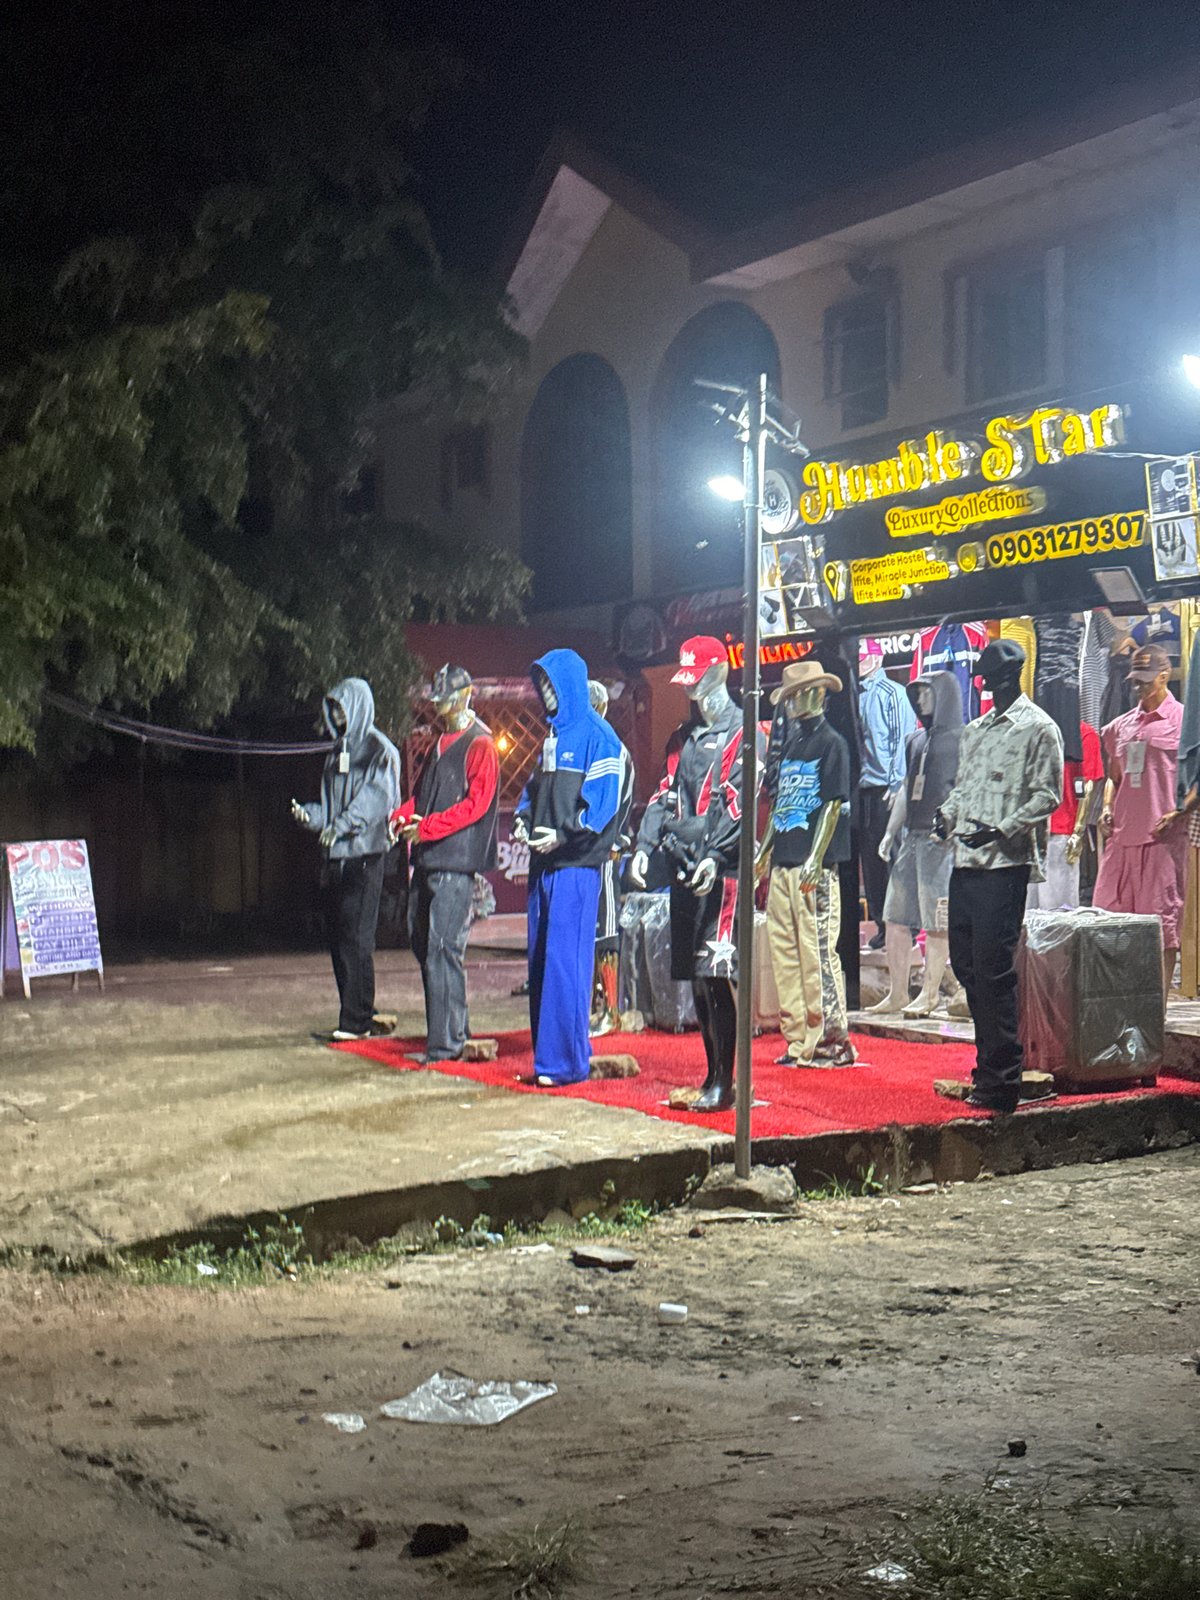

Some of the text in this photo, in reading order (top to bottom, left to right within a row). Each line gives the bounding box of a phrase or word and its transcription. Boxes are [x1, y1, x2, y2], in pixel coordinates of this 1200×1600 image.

[801, 430, 962, 525] Humble
[887, 491, 1034, 531] Luxury Collections
[989, 514, 1145, 564] 09031279307
[851, 550, 924, 574] Corporate Hostel
[874, 569, 907, 584] Miracle
[909, 563, 948, 579] Junction
[7, 840, 86, 873] POS
